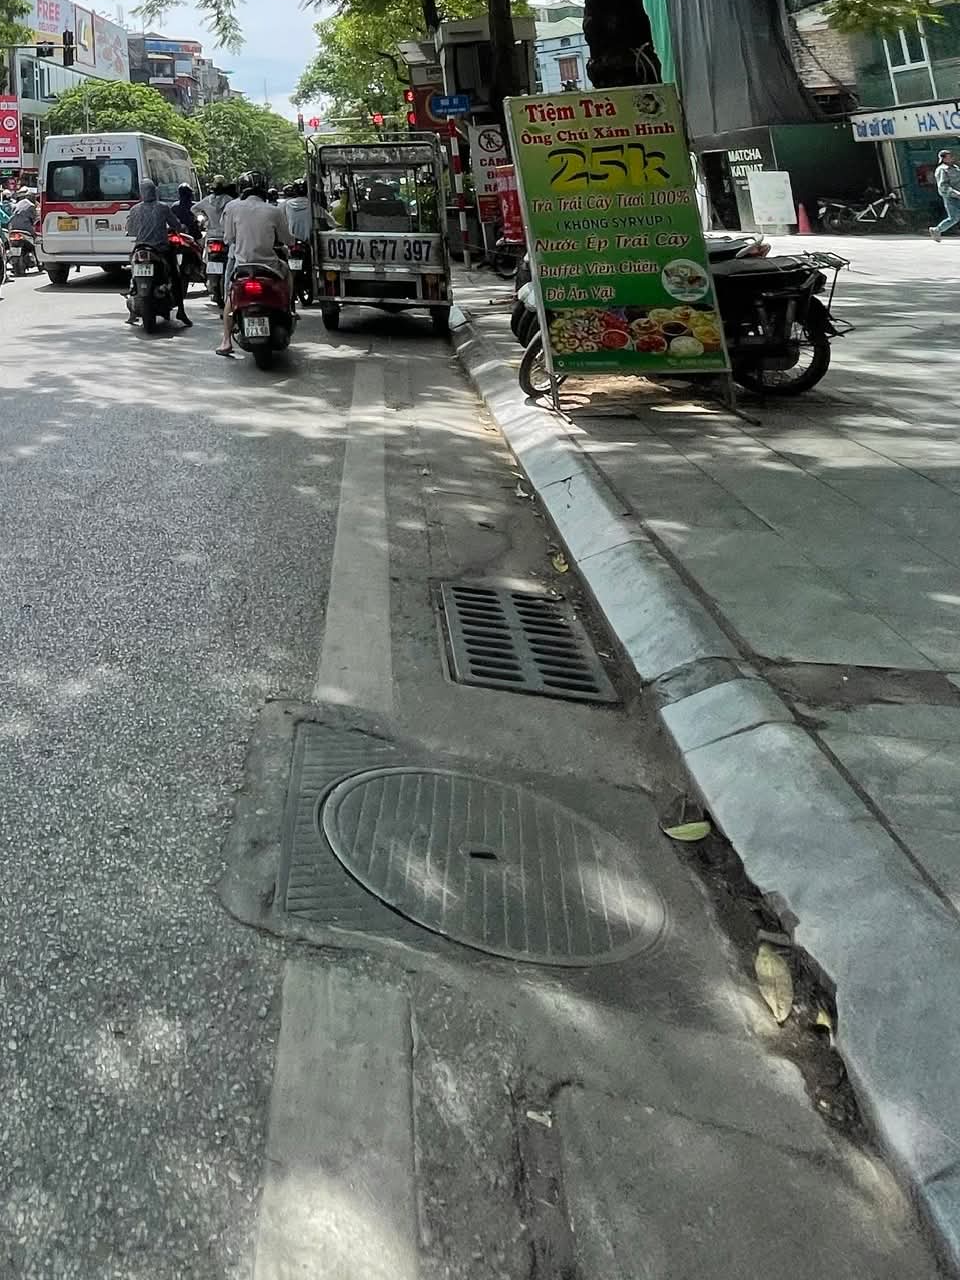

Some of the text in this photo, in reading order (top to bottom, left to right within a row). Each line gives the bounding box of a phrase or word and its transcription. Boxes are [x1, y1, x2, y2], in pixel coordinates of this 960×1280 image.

[524, 96, 618, 127] Tiệm Trà
[521, 130, 553, 146] Ông
[556, 129, 589, 142] Chú
[727, 147, 762, 162] MATCHA
[531, 199, 553, 213] Trà
[557, 194, 582, 211] Trái
[650, 189, 690, 206] 100%
[327, 238, 365, 260] 0974
[402, 239, 433, 261] 397
[534, 231, 691, 254] Nước Ép Trái Cây
[540, 262, 581, 280] Buffet
